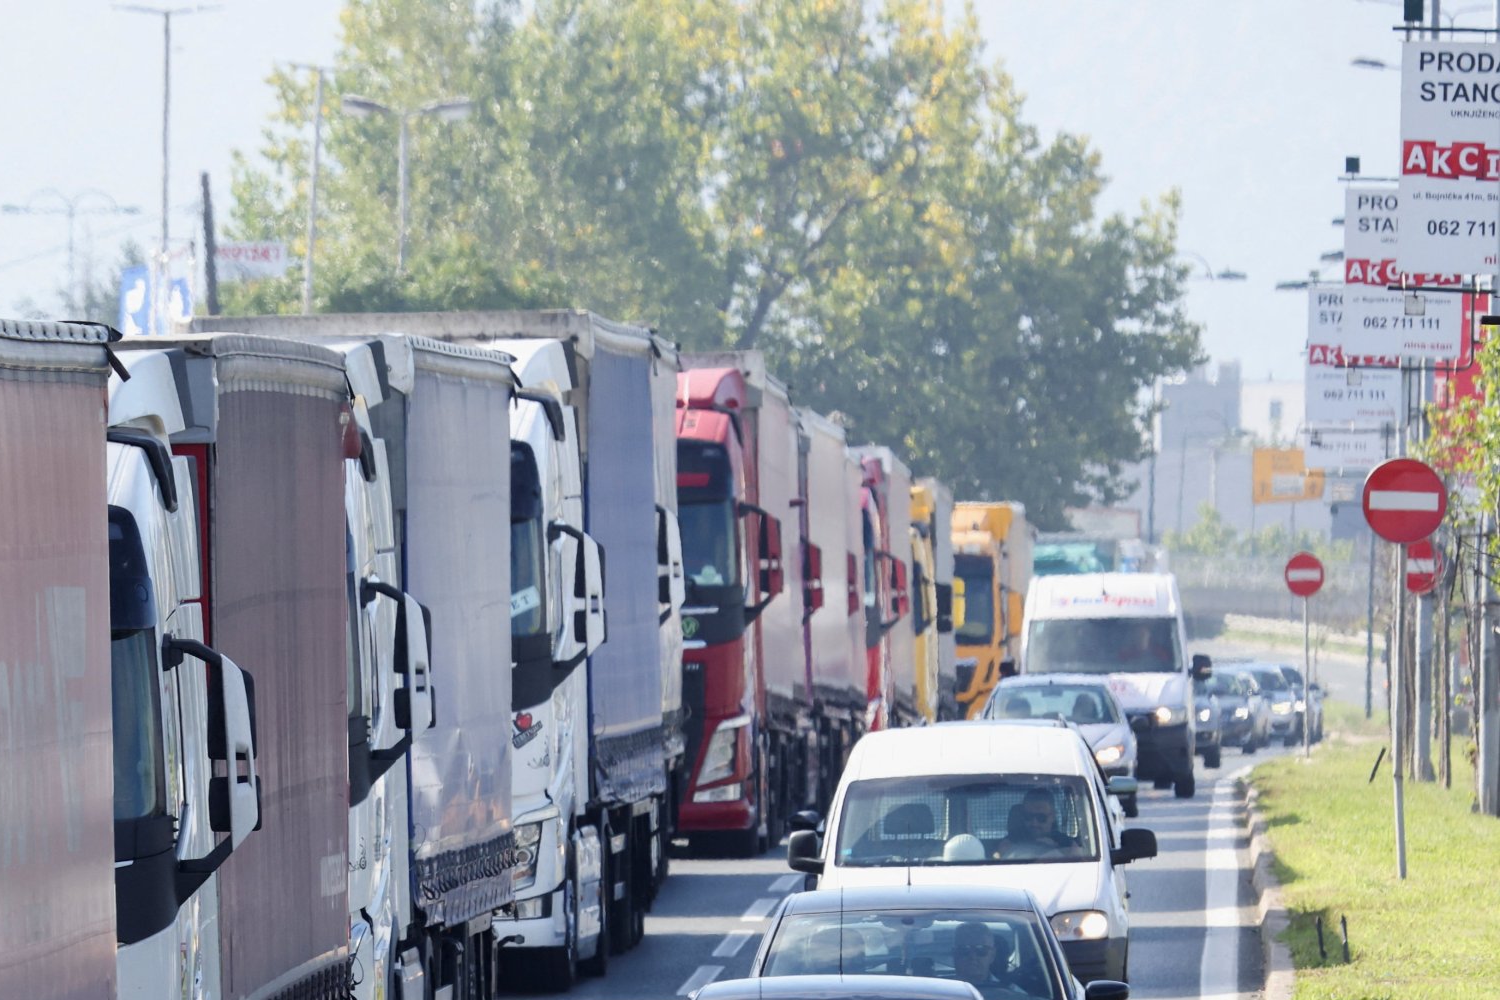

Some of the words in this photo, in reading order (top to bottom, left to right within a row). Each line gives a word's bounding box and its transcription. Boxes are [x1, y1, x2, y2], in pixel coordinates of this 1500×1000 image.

[1420, 52, 1500, 73] PROD
[1358, 217, 1398, 232] STA
[1427, 220, 1460, 235] 062
[1467, 221, 1496, 236] 711
[1363, 316, 1387, 329] 062
[1393, 317, 1413, 330] 711
[1420, 318, 1440, 330] 111
